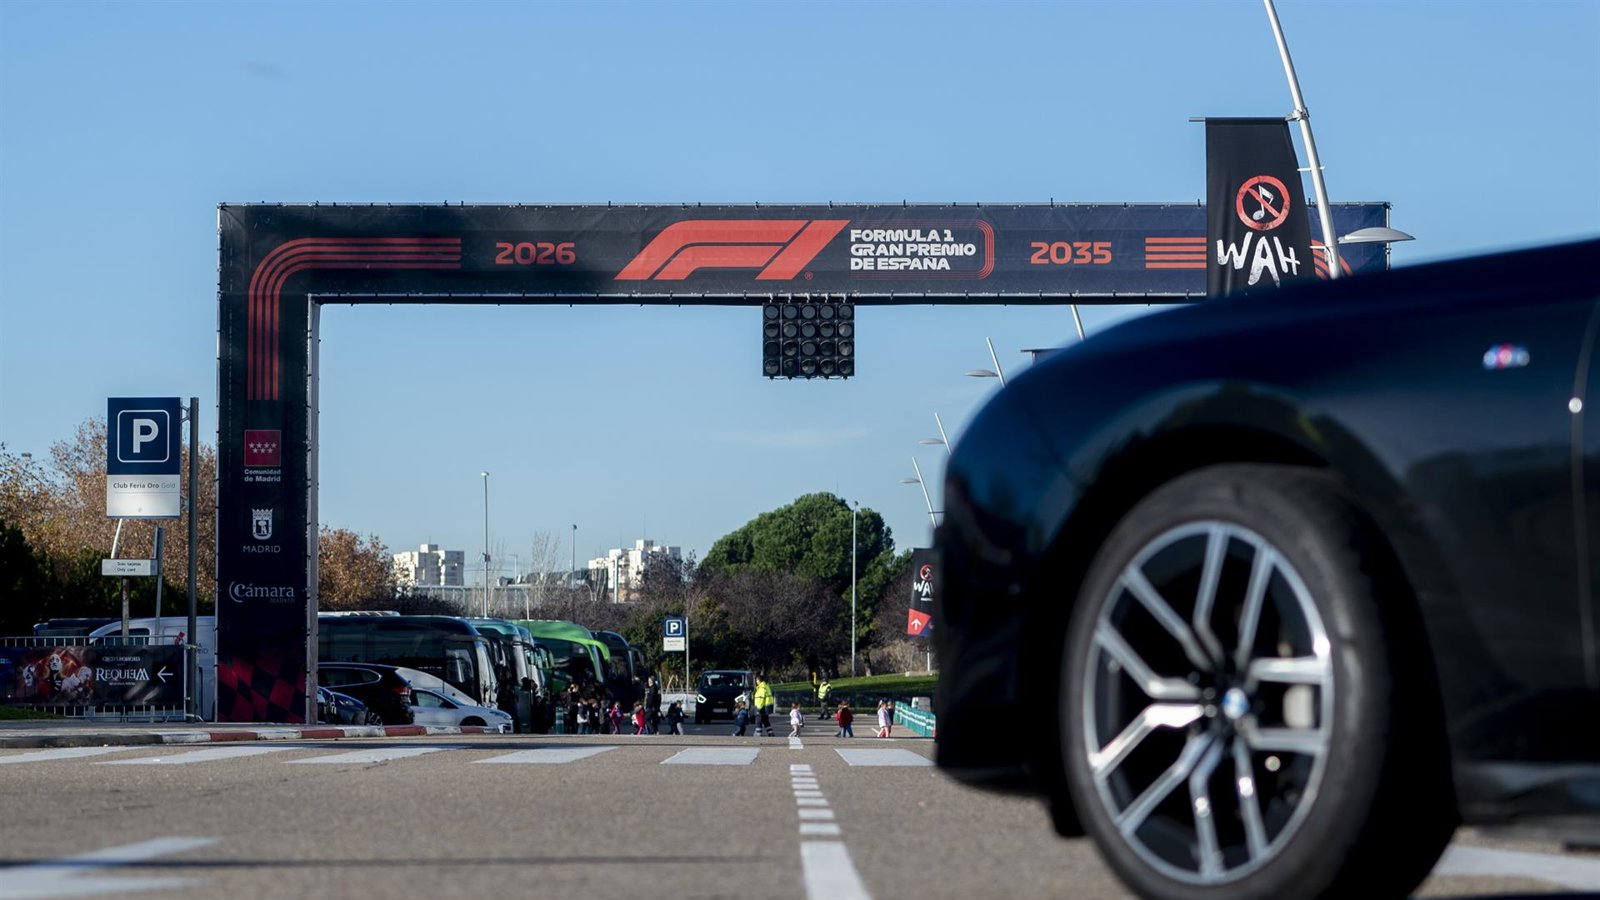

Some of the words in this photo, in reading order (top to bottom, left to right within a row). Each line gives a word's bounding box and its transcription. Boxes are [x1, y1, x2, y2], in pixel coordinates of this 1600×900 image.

[850, 229, 940, 242] FORMULA
[944, 229, 954, 242] 1
[495, 242, 576, 265] 2026
[613, 219, 850, 280] F1
[850, 243, 903, 256] GRAN
[906, 243, 976, 256] PREMIO
[1030, 241, 1112, 264] 2035
[850, 258, 875, 270] DE
[877, 256, 951, 270] ESPAÑA
[1216, 231, 1300, 288] WAH
[132, 418, 159, 454] P
[243, 545, 281, 553] MADRID
[231, 582, 295, 599] Cámara
[670, 622, 679, 633] P
[96, 667, 150, 681] REQUIEM
